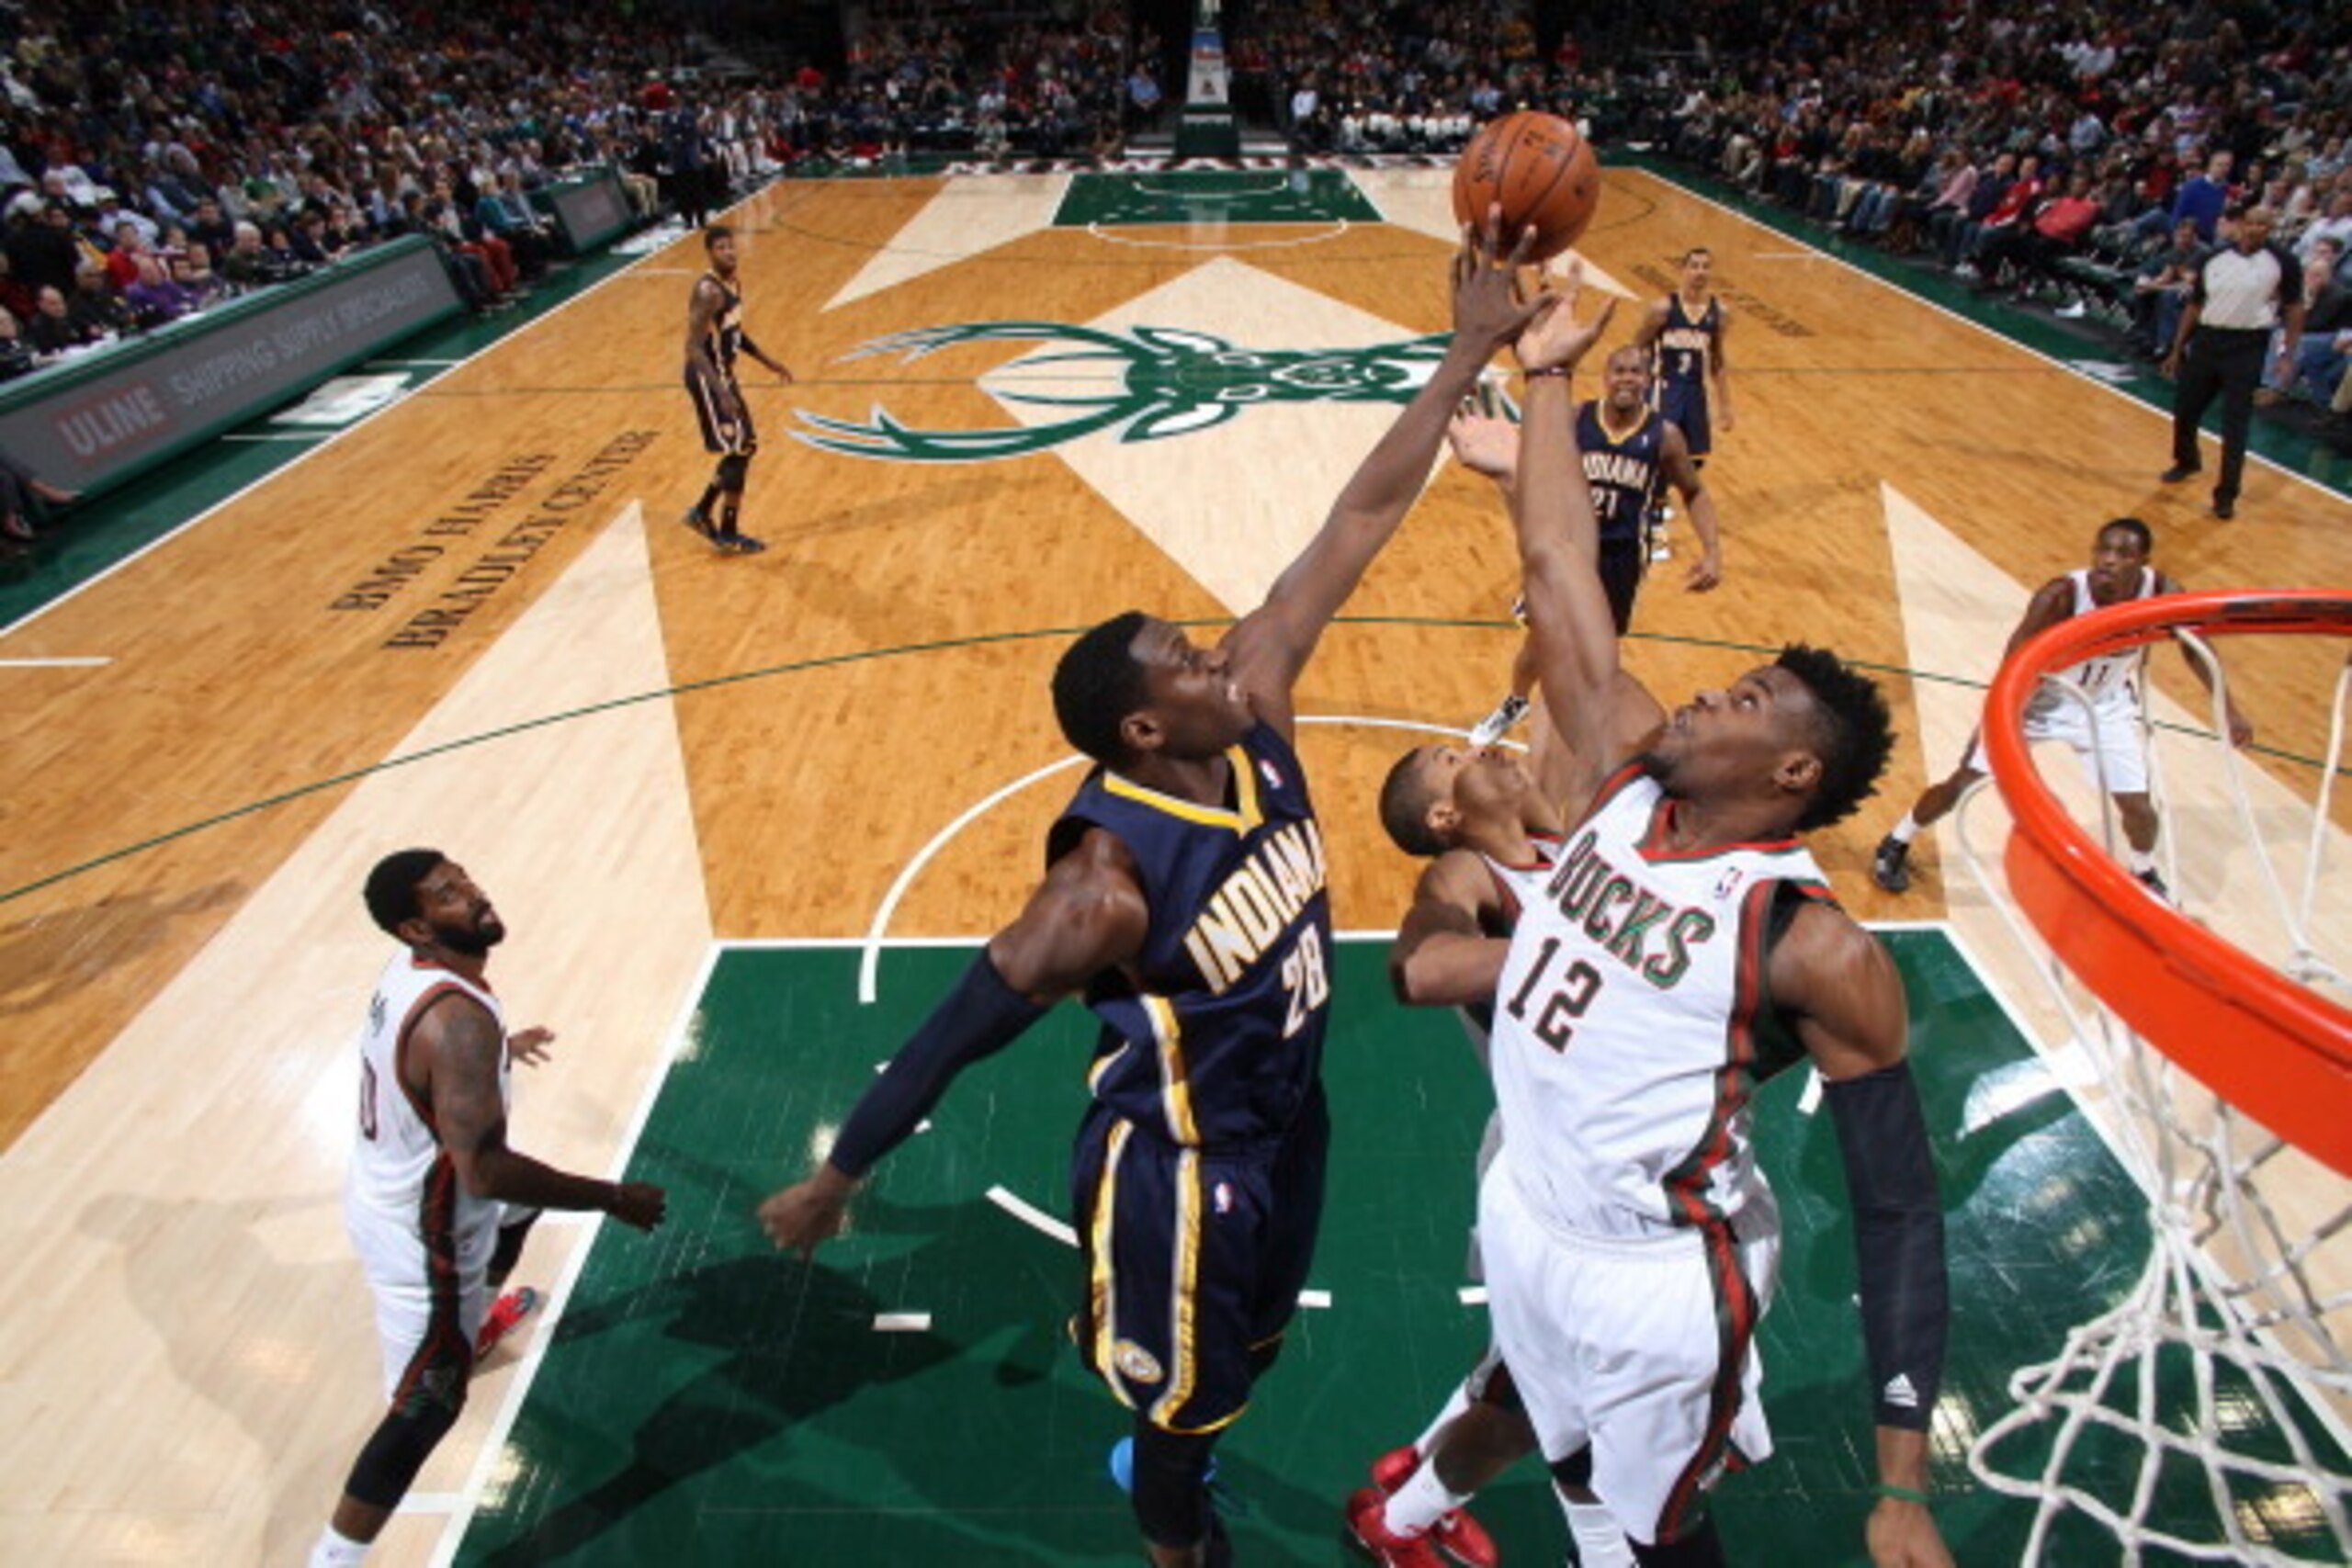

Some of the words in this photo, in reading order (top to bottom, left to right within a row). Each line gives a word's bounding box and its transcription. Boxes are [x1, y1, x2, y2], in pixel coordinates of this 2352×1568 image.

[57, 386, 166, 457] ULINE
[168, 339, 277, 406] SHIPPING
[274, 309, 341, 361] SUPPLY
[328, 546, 445, 611] BMO
[422, 454, 559, 536] HARRIS
[380, 514, 569, 650] BRADLEY
[541, 430, 661, 512] CENTER
[1590, 489, 1620, 518] 21
[1281, 921, 1330, 1040] 28
[1544, 829, 1715, 991] BUCKS
[1507, 936, 1604, 1055] 12
